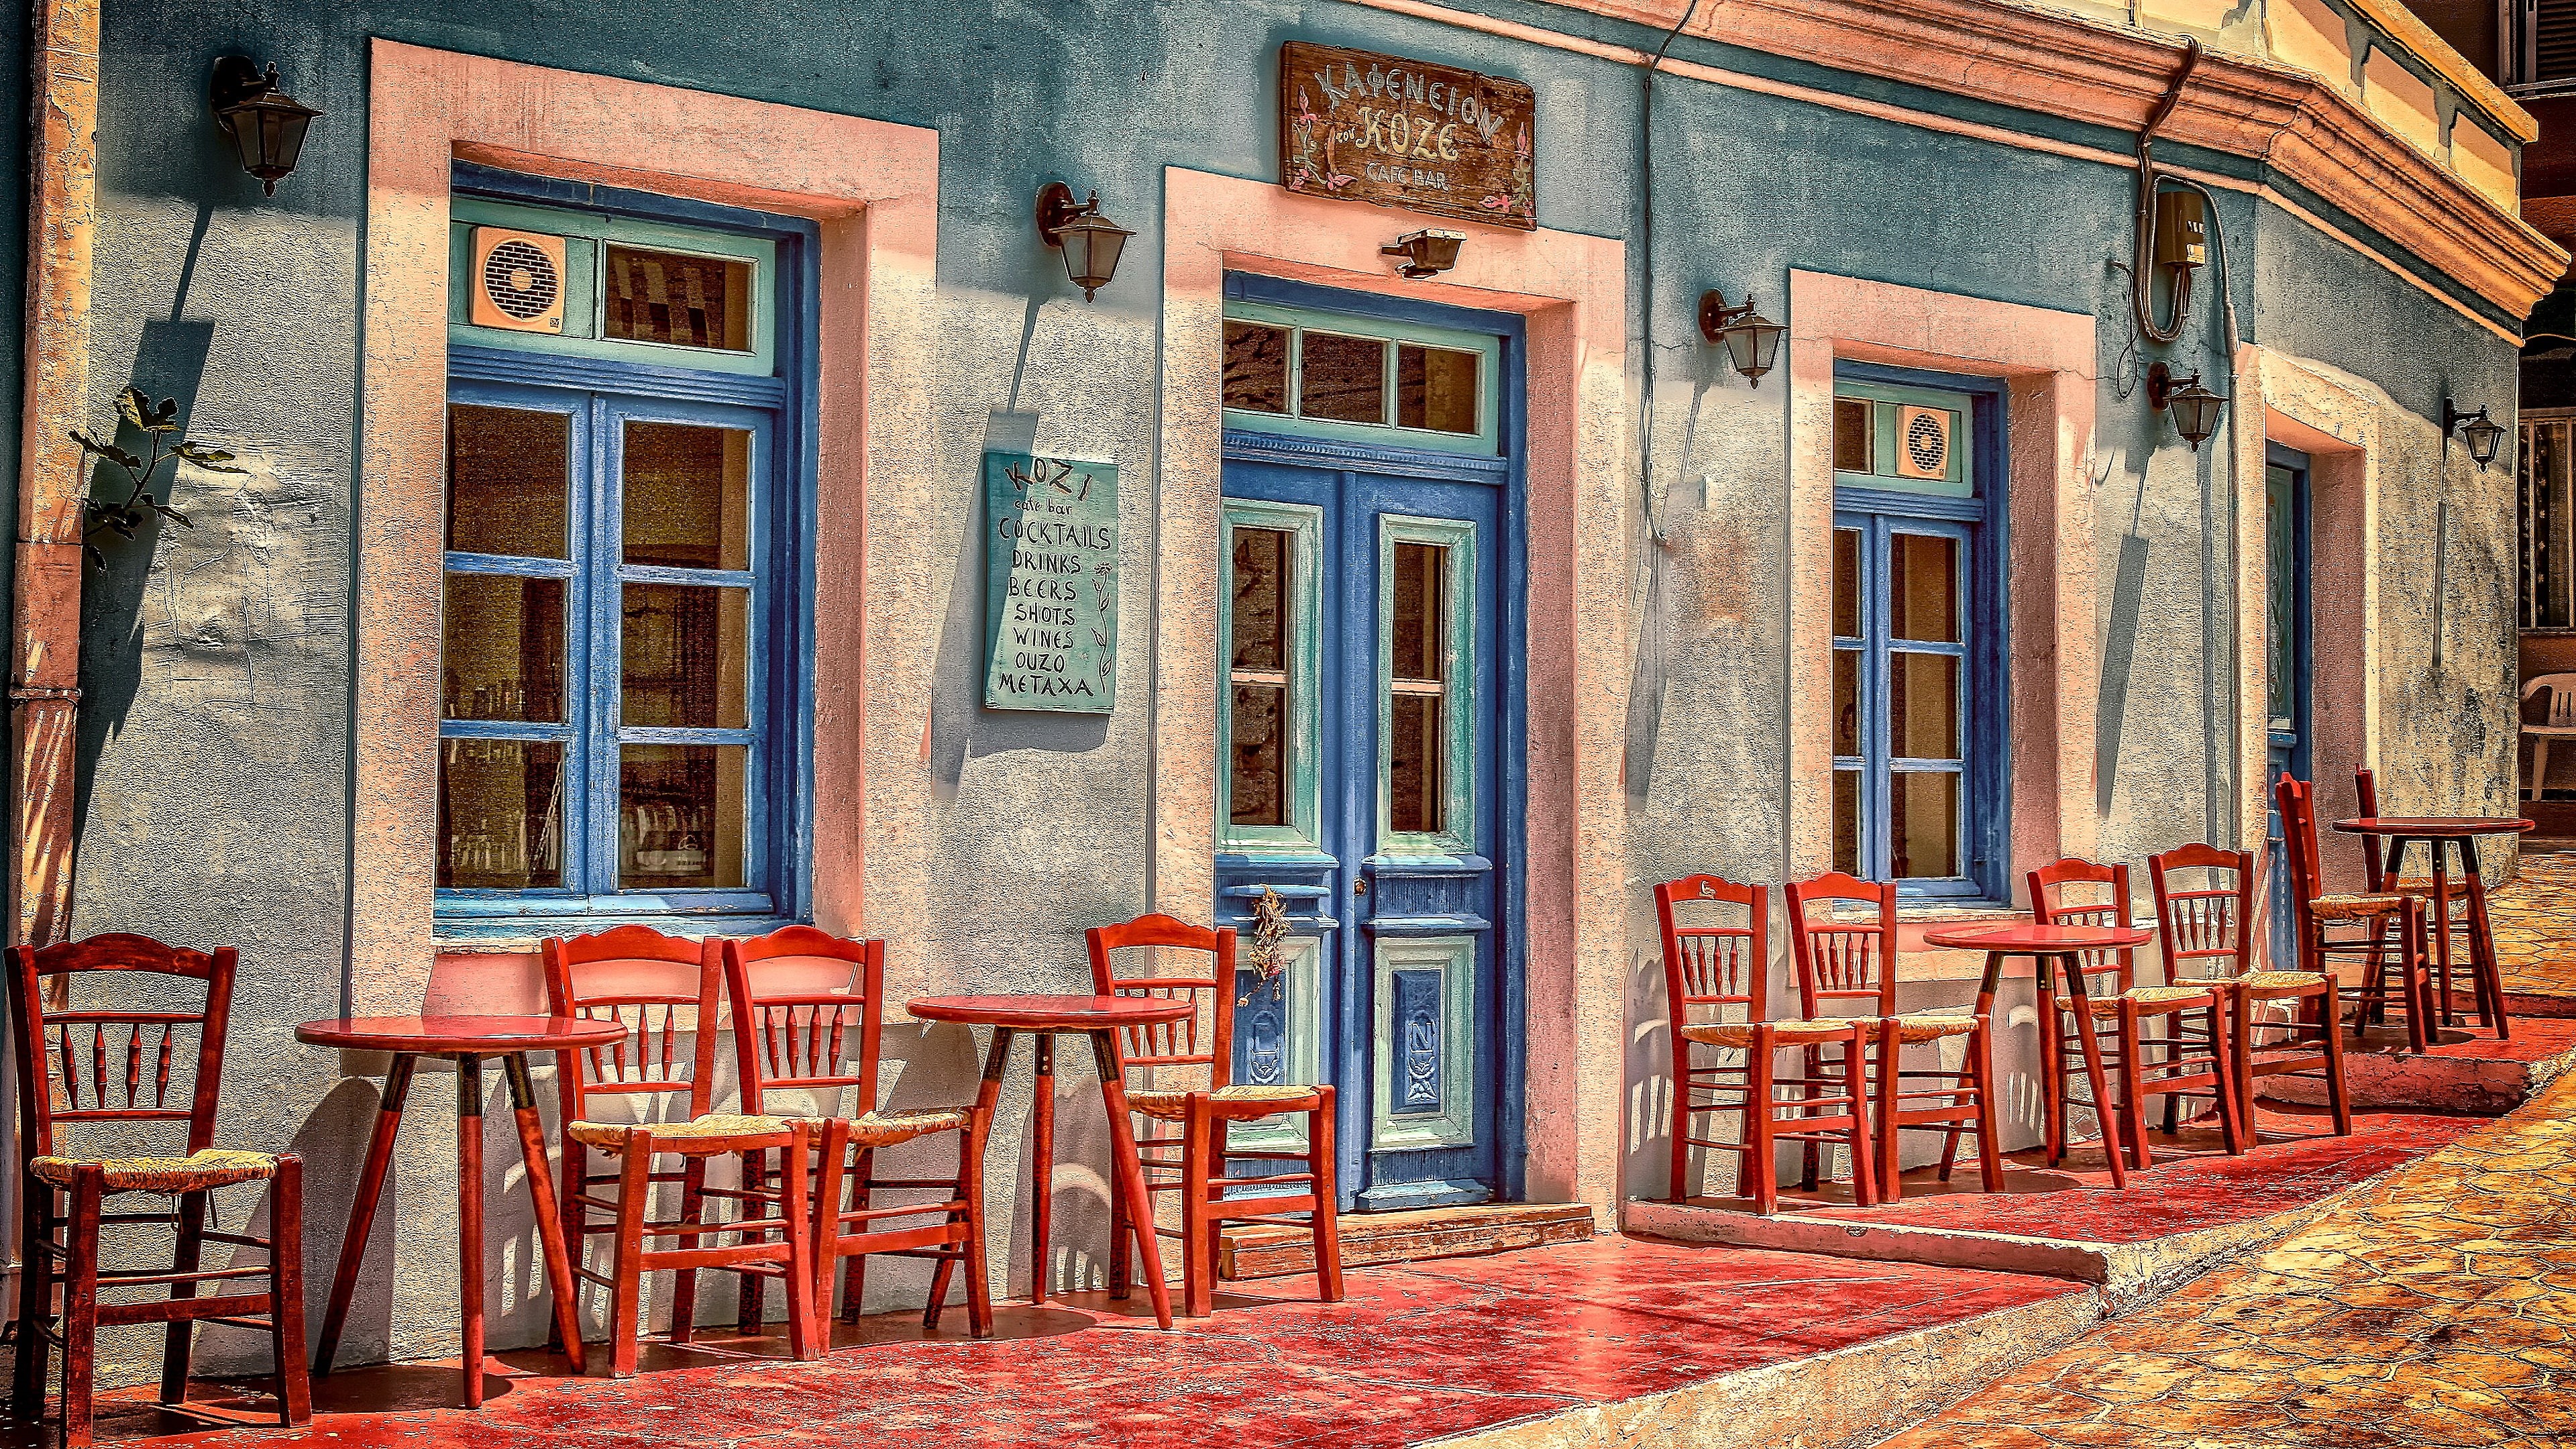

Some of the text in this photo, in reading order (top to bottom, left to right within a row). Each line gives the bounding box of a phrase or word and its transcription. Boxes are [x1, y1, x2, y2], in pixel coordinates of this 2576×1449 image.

[1366, 162, 1450, 192] CAFE BAR
[1014, 497, 1073, 516] cafe bar
[998, 517, 1112, 551] COCKTAILS
[1012, 549, 1083, 575] DRINKS
[1008, 576, 1077, 601] BEERS
[1014, 602, 1076, 627] SHOTS
[1012, 627, 1075, 650] WINES
[1015, 651, 1065, 674] OUZO
[998, 672, 1095, 698] METAXA
